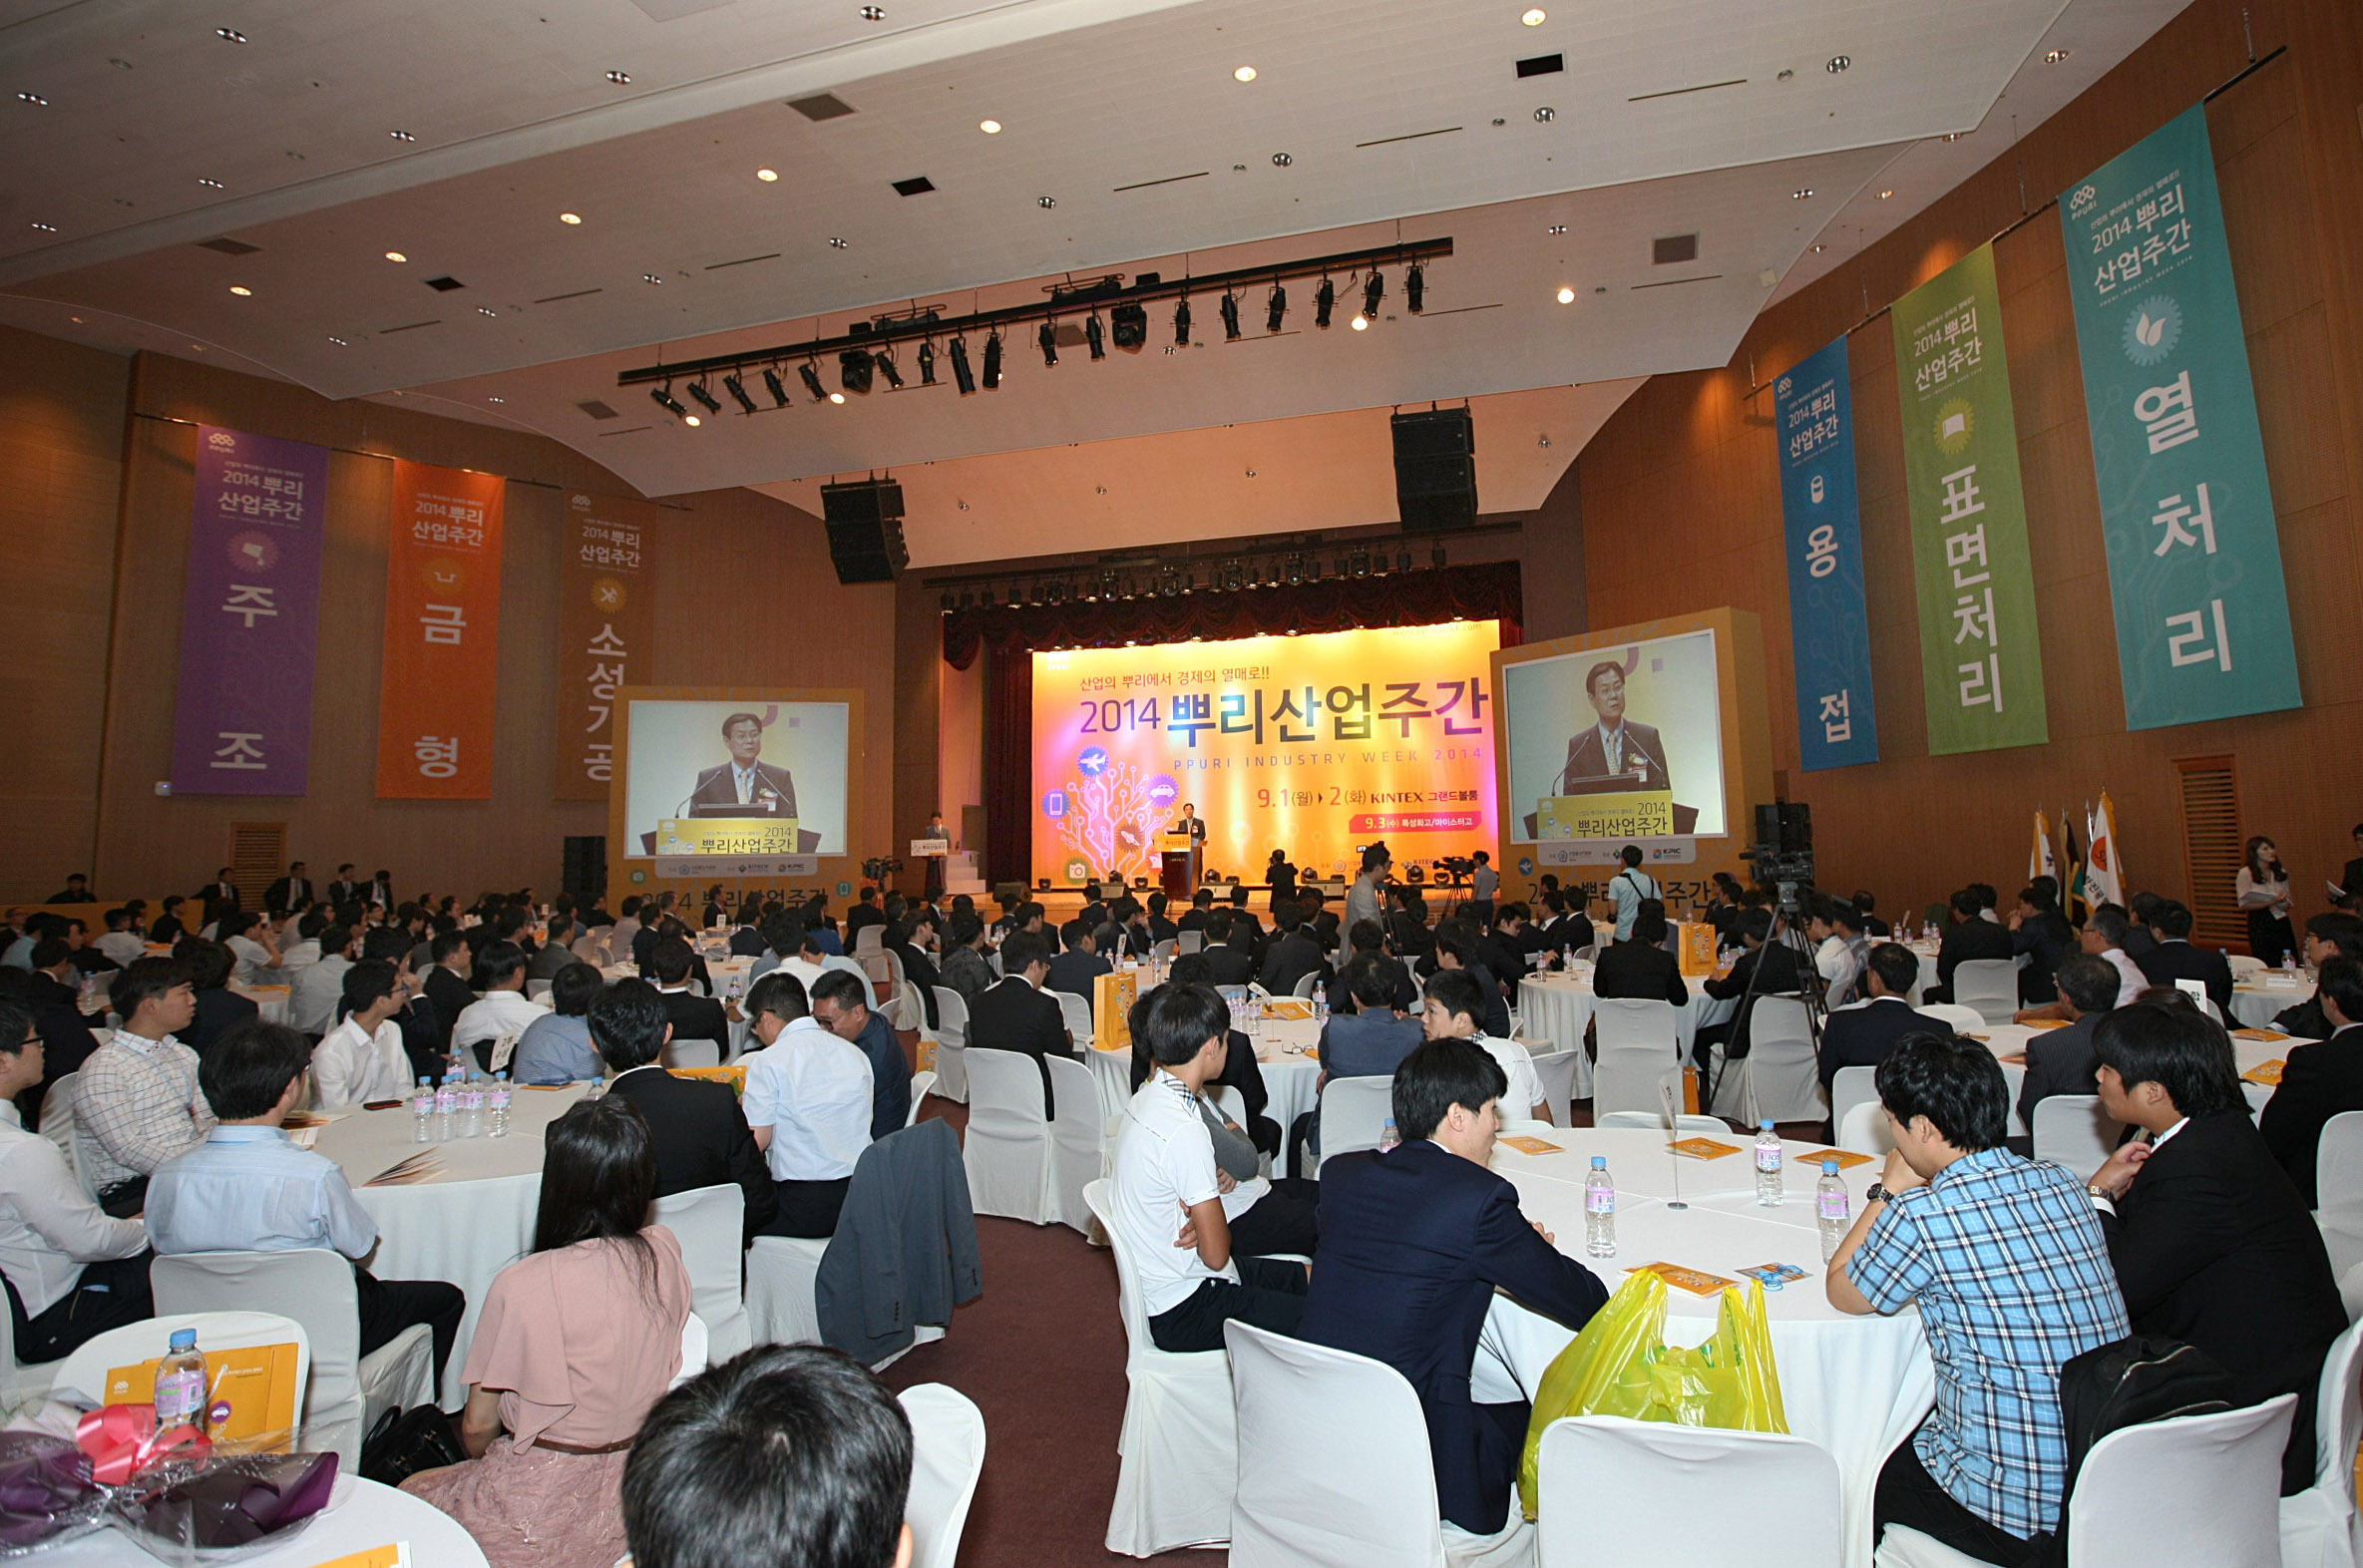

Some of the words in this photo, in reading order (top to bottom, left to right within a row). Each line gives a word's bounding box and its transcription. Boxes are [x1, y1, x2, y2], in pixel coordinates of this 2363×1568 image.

[2092, 216, 2133, 254] 2014
[2136, 184, 2184, 232] 뿌리
[2094, 217, 2191, 294] 산업주간
[1914, 329, 1942, 357] 2014
[1944, 306, 1978, 345] 뿌리
[1915, 335, 1983, 392] 산업주간
[1788, 405, 1810, 429] 2014
[1810, 388, 1835, 420] 뿌리
[1789, 413, 1839, 459] 산업주간
[222, 469, 260, 488] 2014
[261, 476, 303, 501] 뿌리
[217, 491, 304, 521] 산업주간
[415, 501, 447, 517] 2014
[448, 506, 483, 528] 뿌리
[411, 521, 485, 548] 산업주간
[2133, 370, 2233, 673] 열처리
[582, 526, 609, 540] 2014
[610, 530, 640, 551] 뿌리
[580, 544, 641, 569] 산업주간
[1939, 463, 2004, 715] 표면처리
[1079, 675, 1116, 691] 산업의
[1121, 672, 1172, 688] 뿌리에서
[1177, 669, 1216, 685] 경제의
[1221, 665, 1270, 682] 열매로!!
[1080, 697, 1162, 733] 2014
[1167, 677, 1489, 748] 뿌리산업주간
[1174, 757, 1233, 771] PPURI
[1246, 753, 1347, 767] INDUSTRY
[1363, 750, 1418, 763] WEEK
[1434, 747, 1482, 761] 2014
[1371, 791, 1424, 804] KINTEX
[1427, 790, 1479, 802] 그랜드볼룸
[1637, 801, 1667, 816] 2014
[764, 826, 792, 838] 2014
[1577, 816, 1669, 838] 뿌리산업주간
[700, 838, 793, 854] 뿌리산업주간
